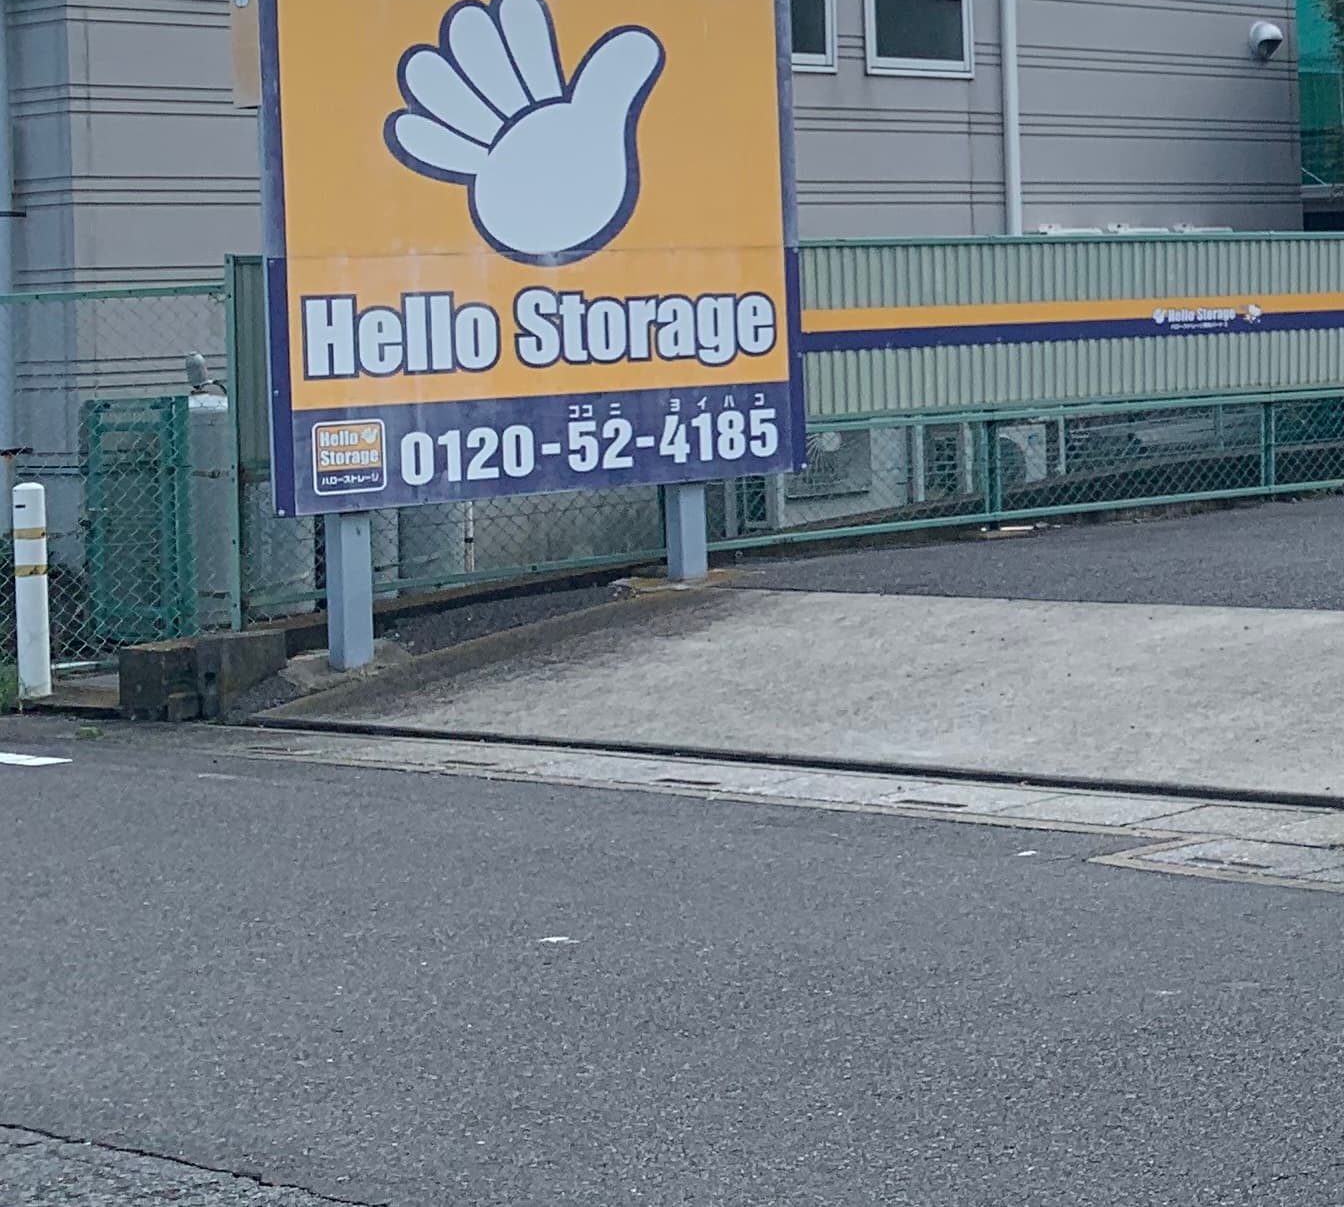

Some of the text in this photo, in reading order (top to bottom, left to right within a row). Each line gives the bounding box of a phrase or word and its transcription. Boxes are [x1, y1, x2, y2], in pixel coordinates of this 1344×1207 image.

[302, 286, 776, 382] Hello Storage
[320, 430, 358, 447] Hello
[400, 408, 779, 487] 0120-52-4185
[320, 449, 379, 466] Storage
[321, 472, 379, 485] ハローストレージ
